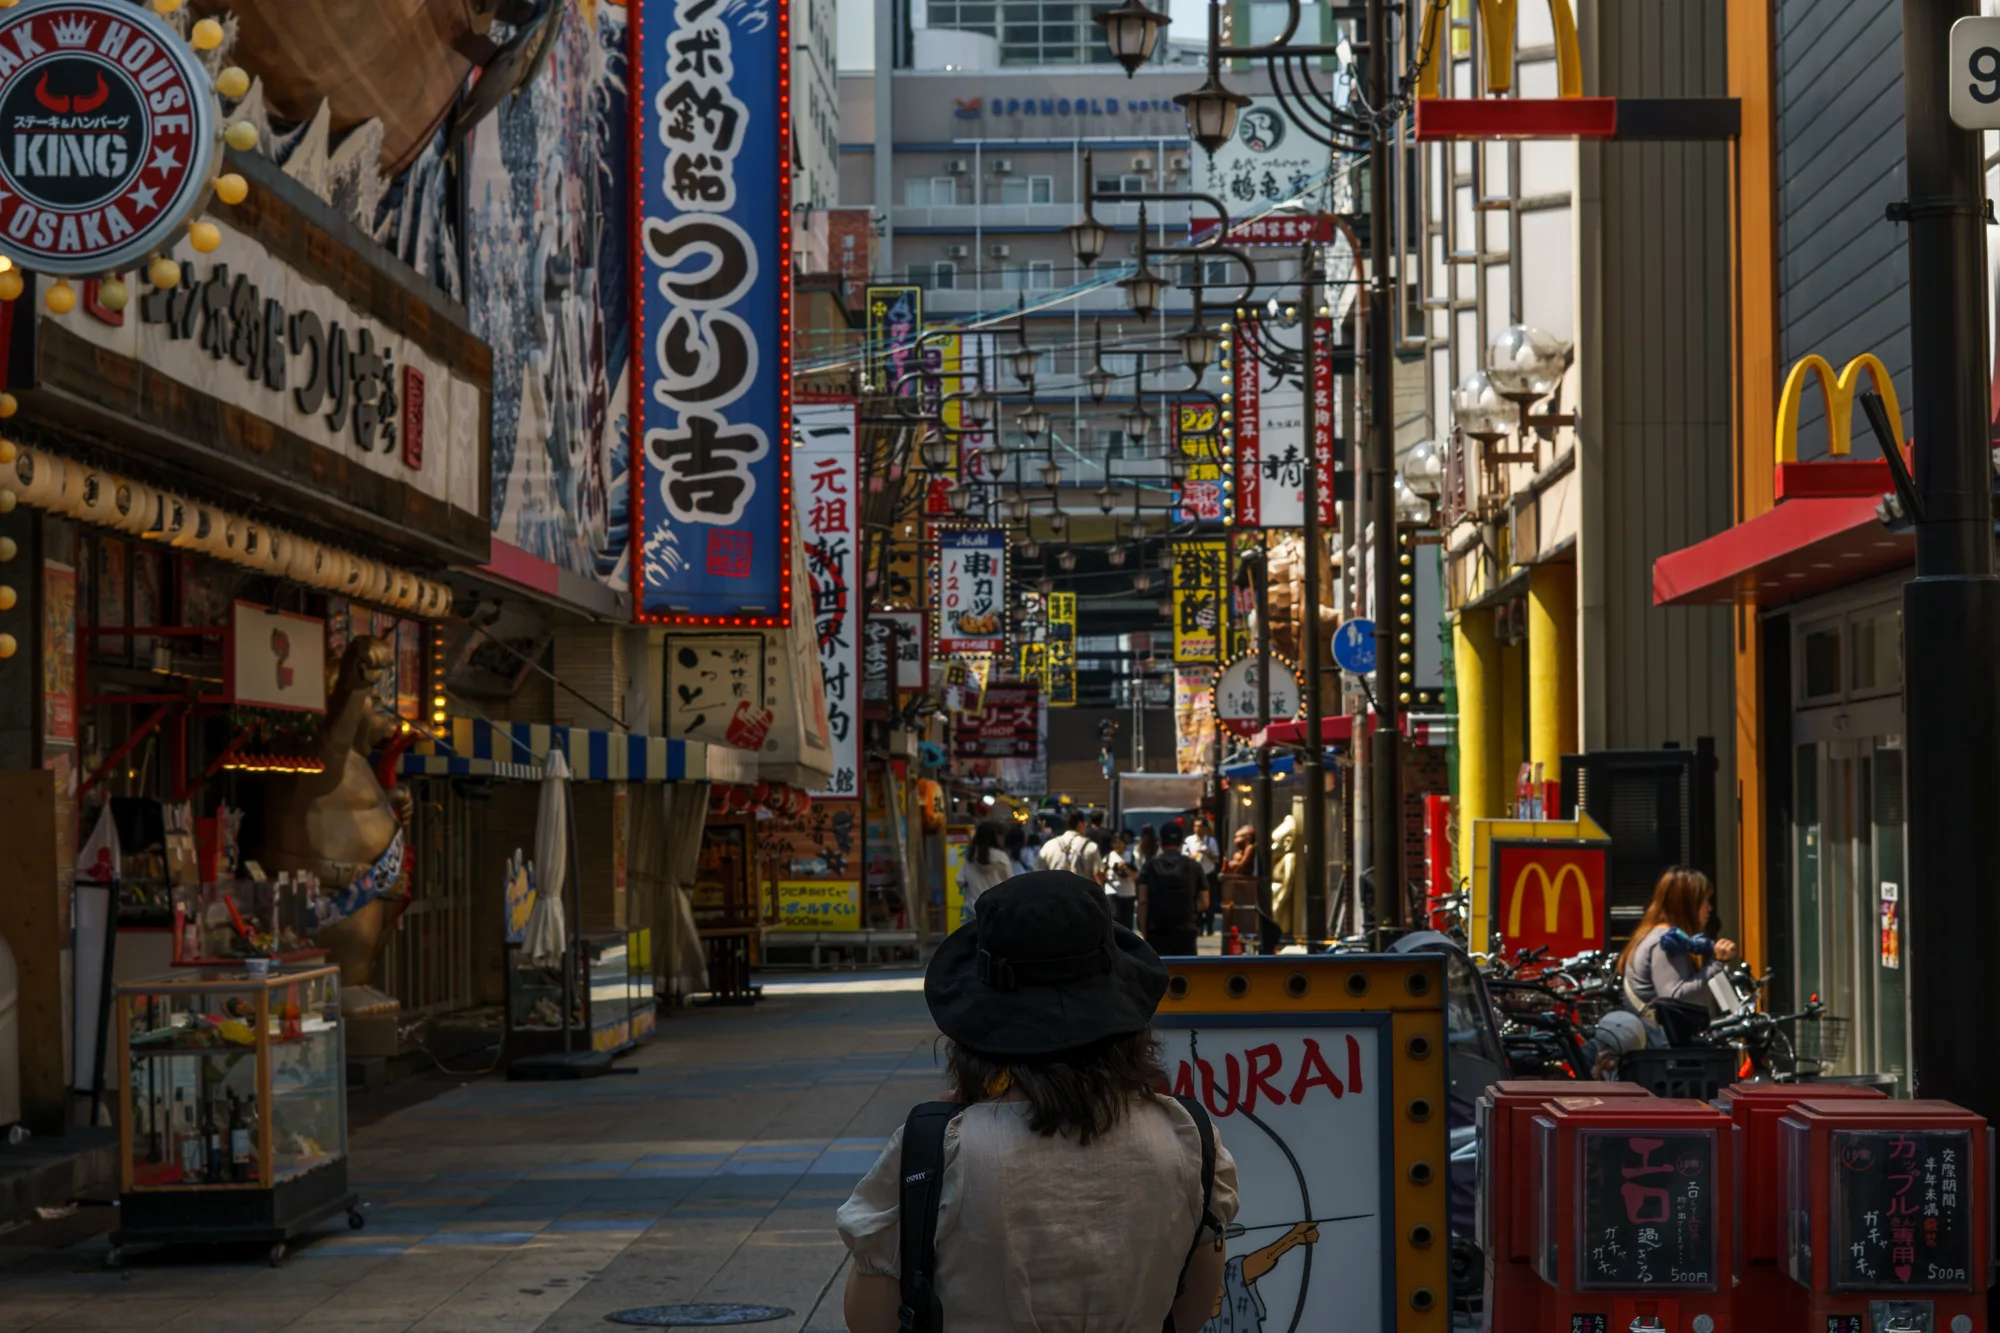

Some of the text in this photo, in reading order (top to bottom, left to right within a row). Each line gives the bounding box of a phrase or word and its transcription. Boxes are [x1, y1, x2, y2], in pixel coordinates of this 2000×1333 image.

[98, 20, 190, 136] HOUSE
[1968, 46, 2000, 104] 9
[13, 133, 128, 178] KING
[8, 203, 134, 251] OSAKA
[956, 533, 988, 547] Asahi
[963, 550, 993, 616] 串カツ
[979, 726, 1016, 736] SHOP
[905, 1171, 926, 1184] OSPREY
[1670, 1267, 1709, 1283] 500円
[1927, 1262, 1966, 1280] 500円
